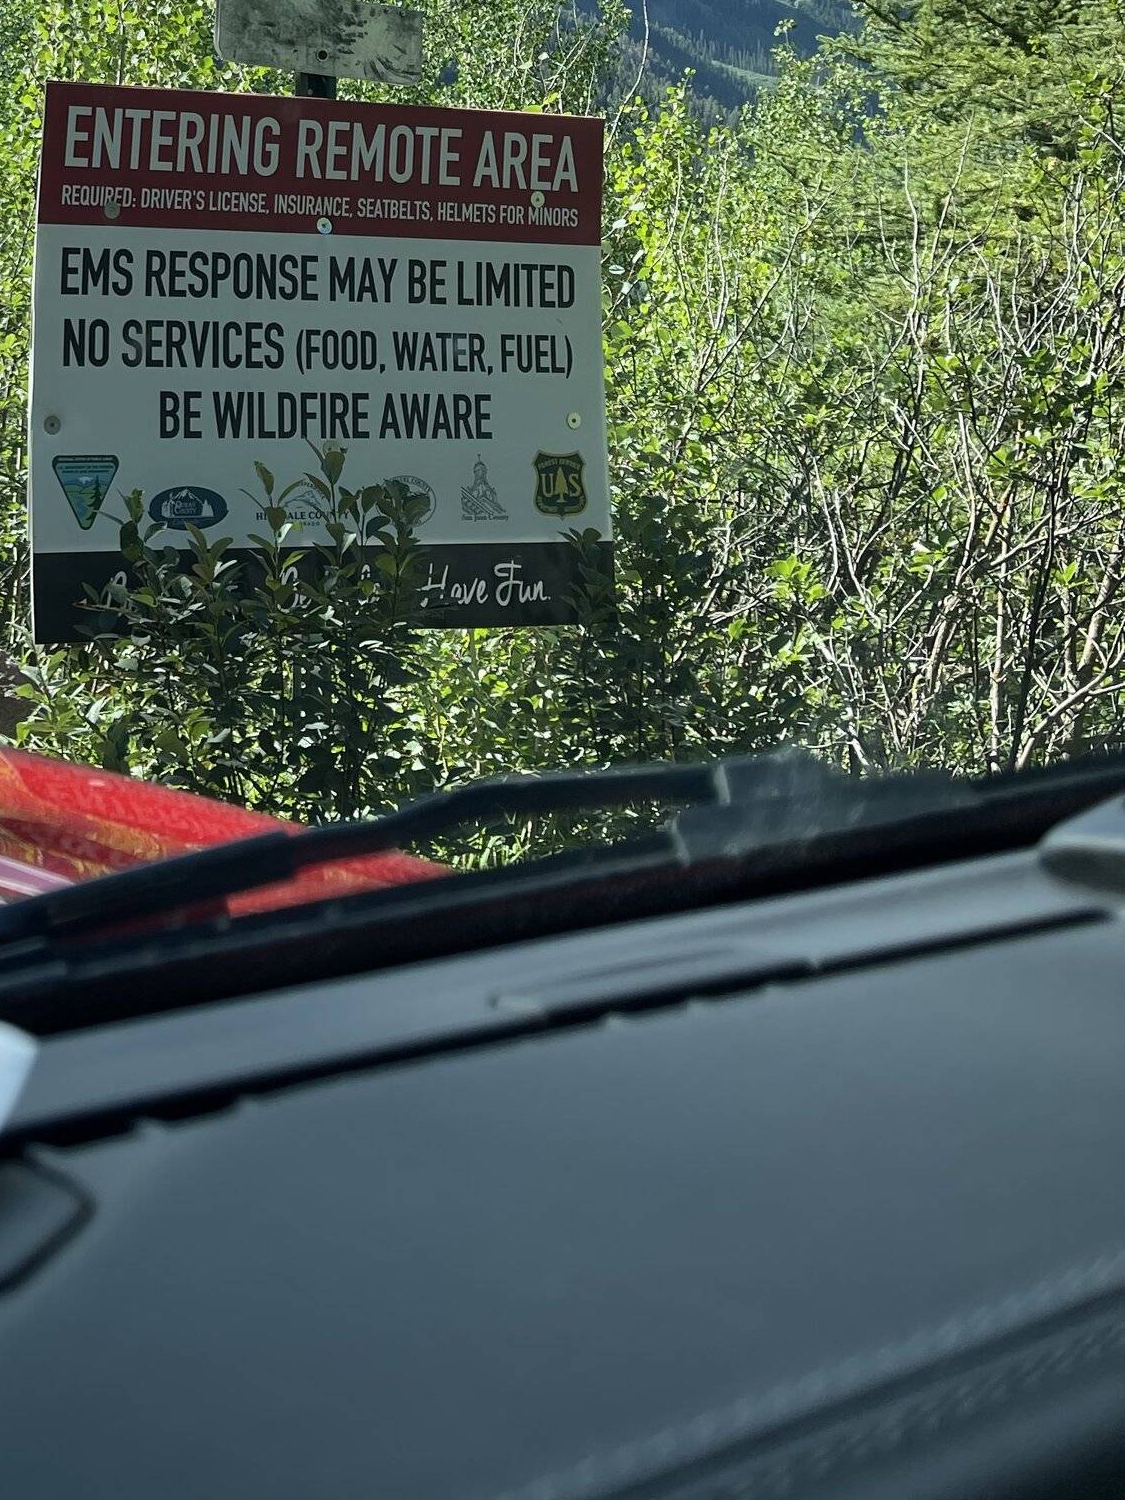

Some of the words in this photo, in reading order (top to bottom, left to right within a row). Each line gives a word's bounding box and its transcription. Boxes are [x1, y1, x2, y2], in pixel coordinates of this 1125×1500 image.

[63, 105, 281, 178] ENTERING
[295, 118, 463, 187] REMOTE
[472, 130, 580, 193] AREA
[61, 184, 137, 208] REQUIRED:
[141, 188, 205, 211] DRIVER'S
[209, 190, 270, 215] LICENSE,
[274, 193, 353, 218] INSURANCE,
[356, 197, 434, 223] SEATBELTS,
[437, 201, 496, 224] HELMETS
[499, 203, 525, 225] FOR
[528, 206, 579, 228] MINORS
[59, 246, 134, 296] EMS
[145, 249, 319, 302] RESPONSE
[328, 255, 399, 304] MAY
[408, 259, 452, 304] BE
[456, 261, 576, 309] LIMITED
[62, 317, 109, 368] NO
[121, 320, 285, 370] SERVICES
[295, 327, 386, 375] (FOOD,
[392, 330, 494, 377] WATER,
[500, 333, 574, 380] FUEL)
[158, 389, 203, 440] BE
[212, 391, 371, 441] WILDFIRE
[378, 393, 494, 441] AWARE
[416, 562, 489, 608] Have
